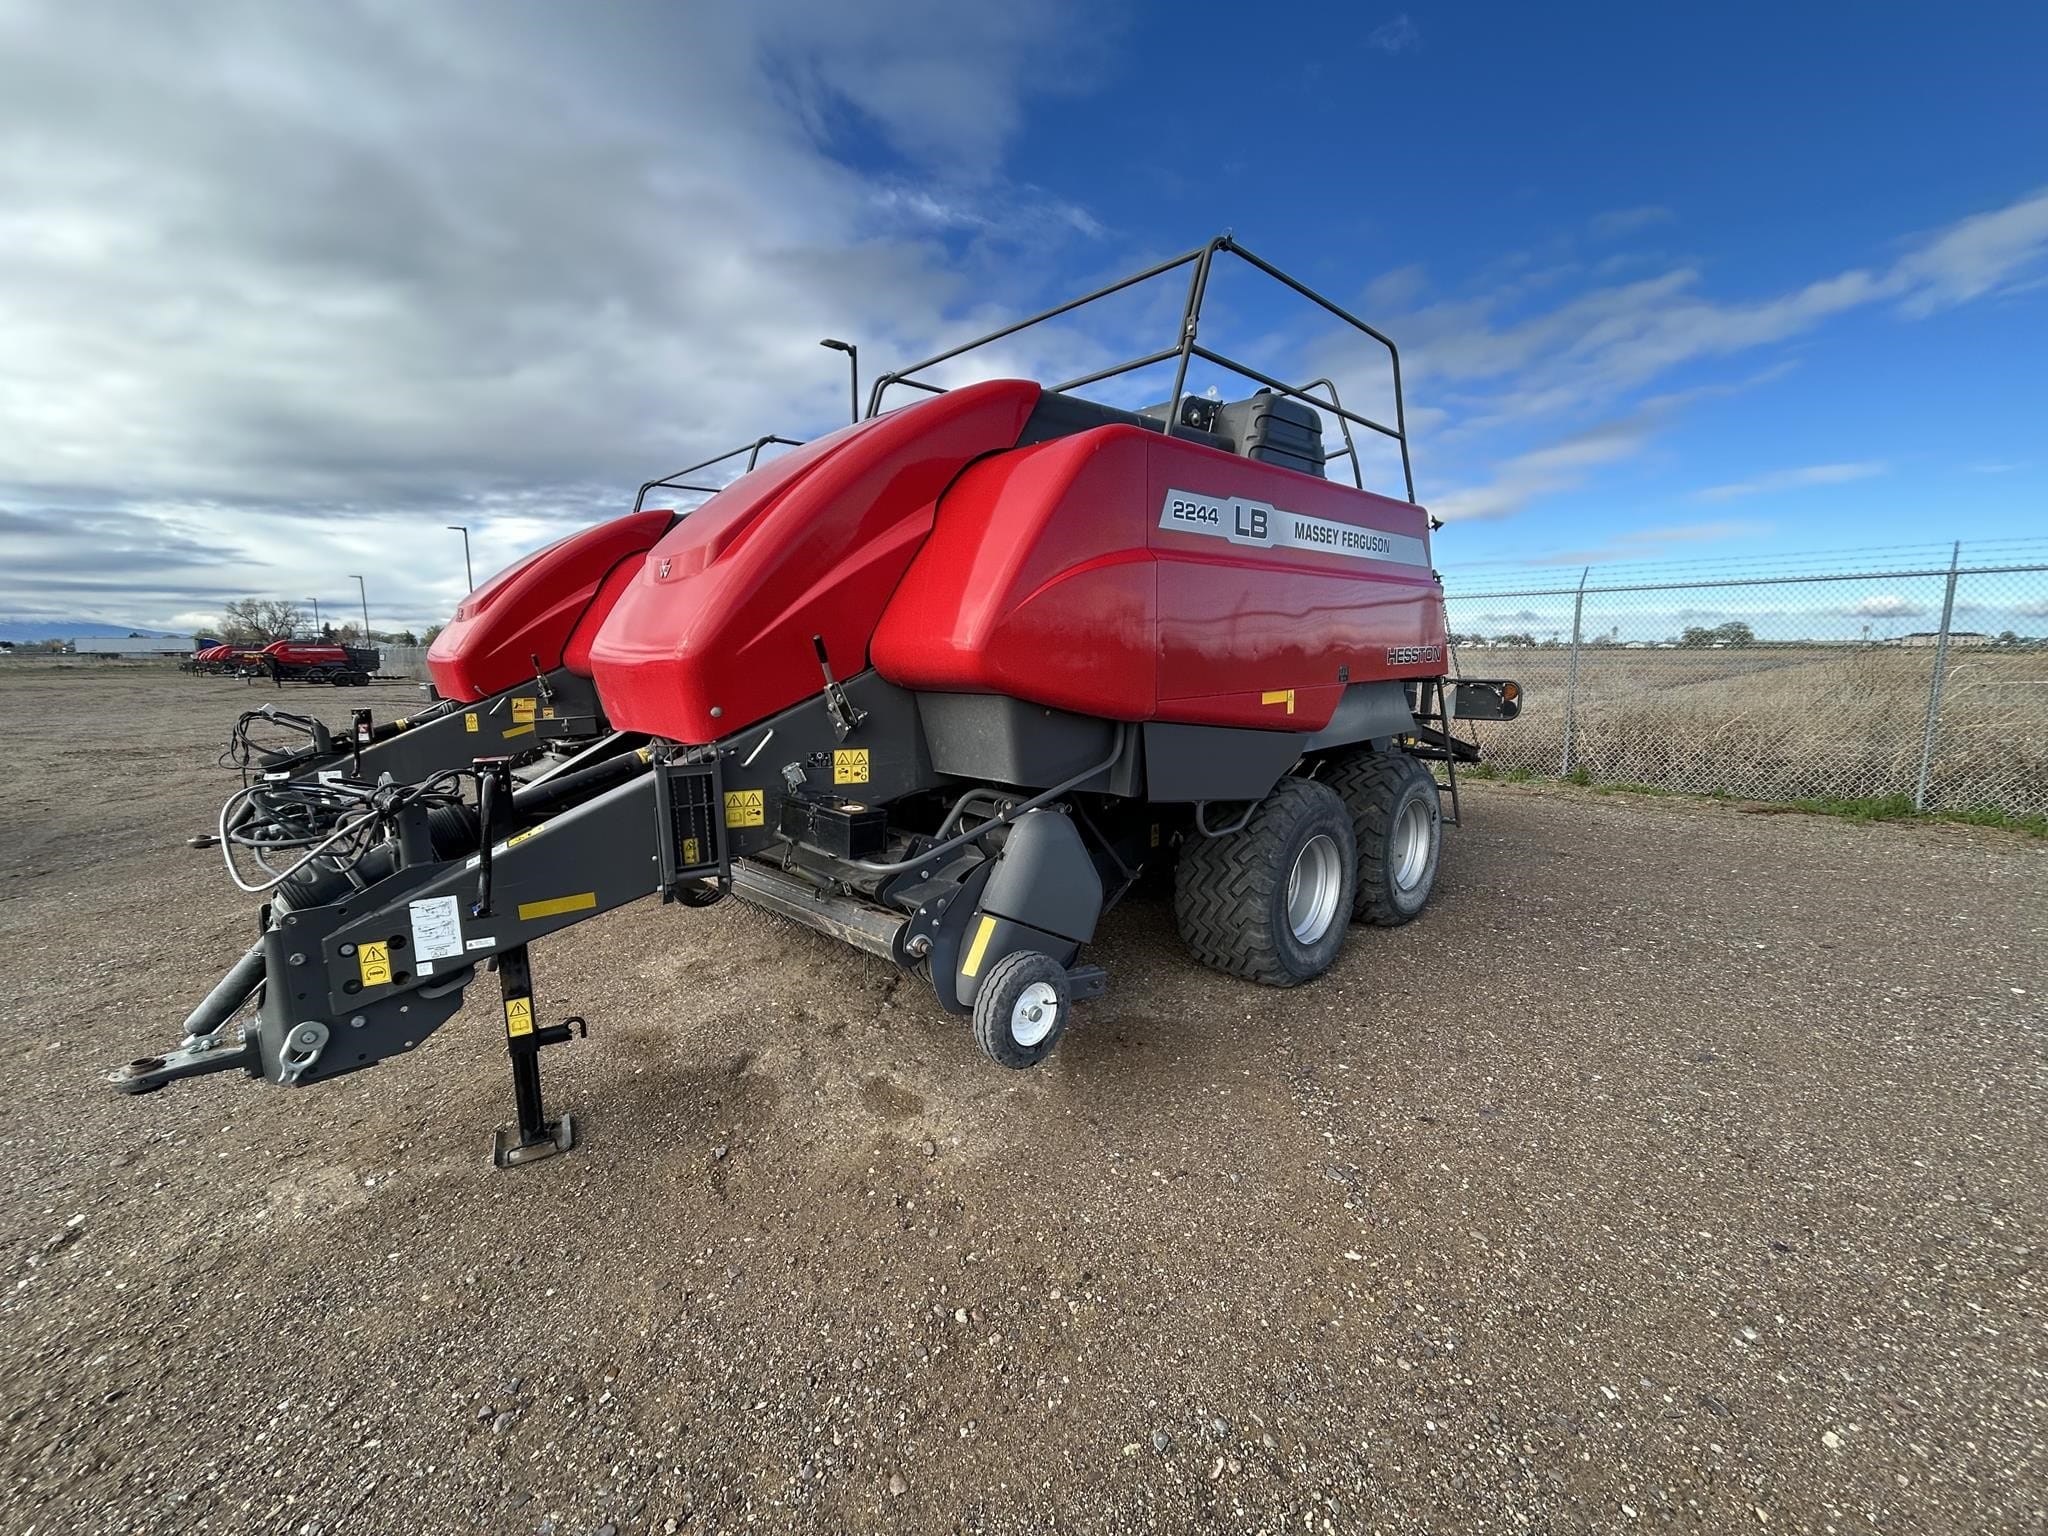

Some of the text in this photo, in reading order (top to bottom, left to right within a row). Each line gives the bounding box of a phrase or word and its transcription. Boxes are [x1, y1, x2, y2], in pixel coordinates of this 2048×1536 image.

[1173, 500, 1391, 554] 2244 LB MASSEY FERGUSON
[1386, 645, 1442, 666] HESSTON
